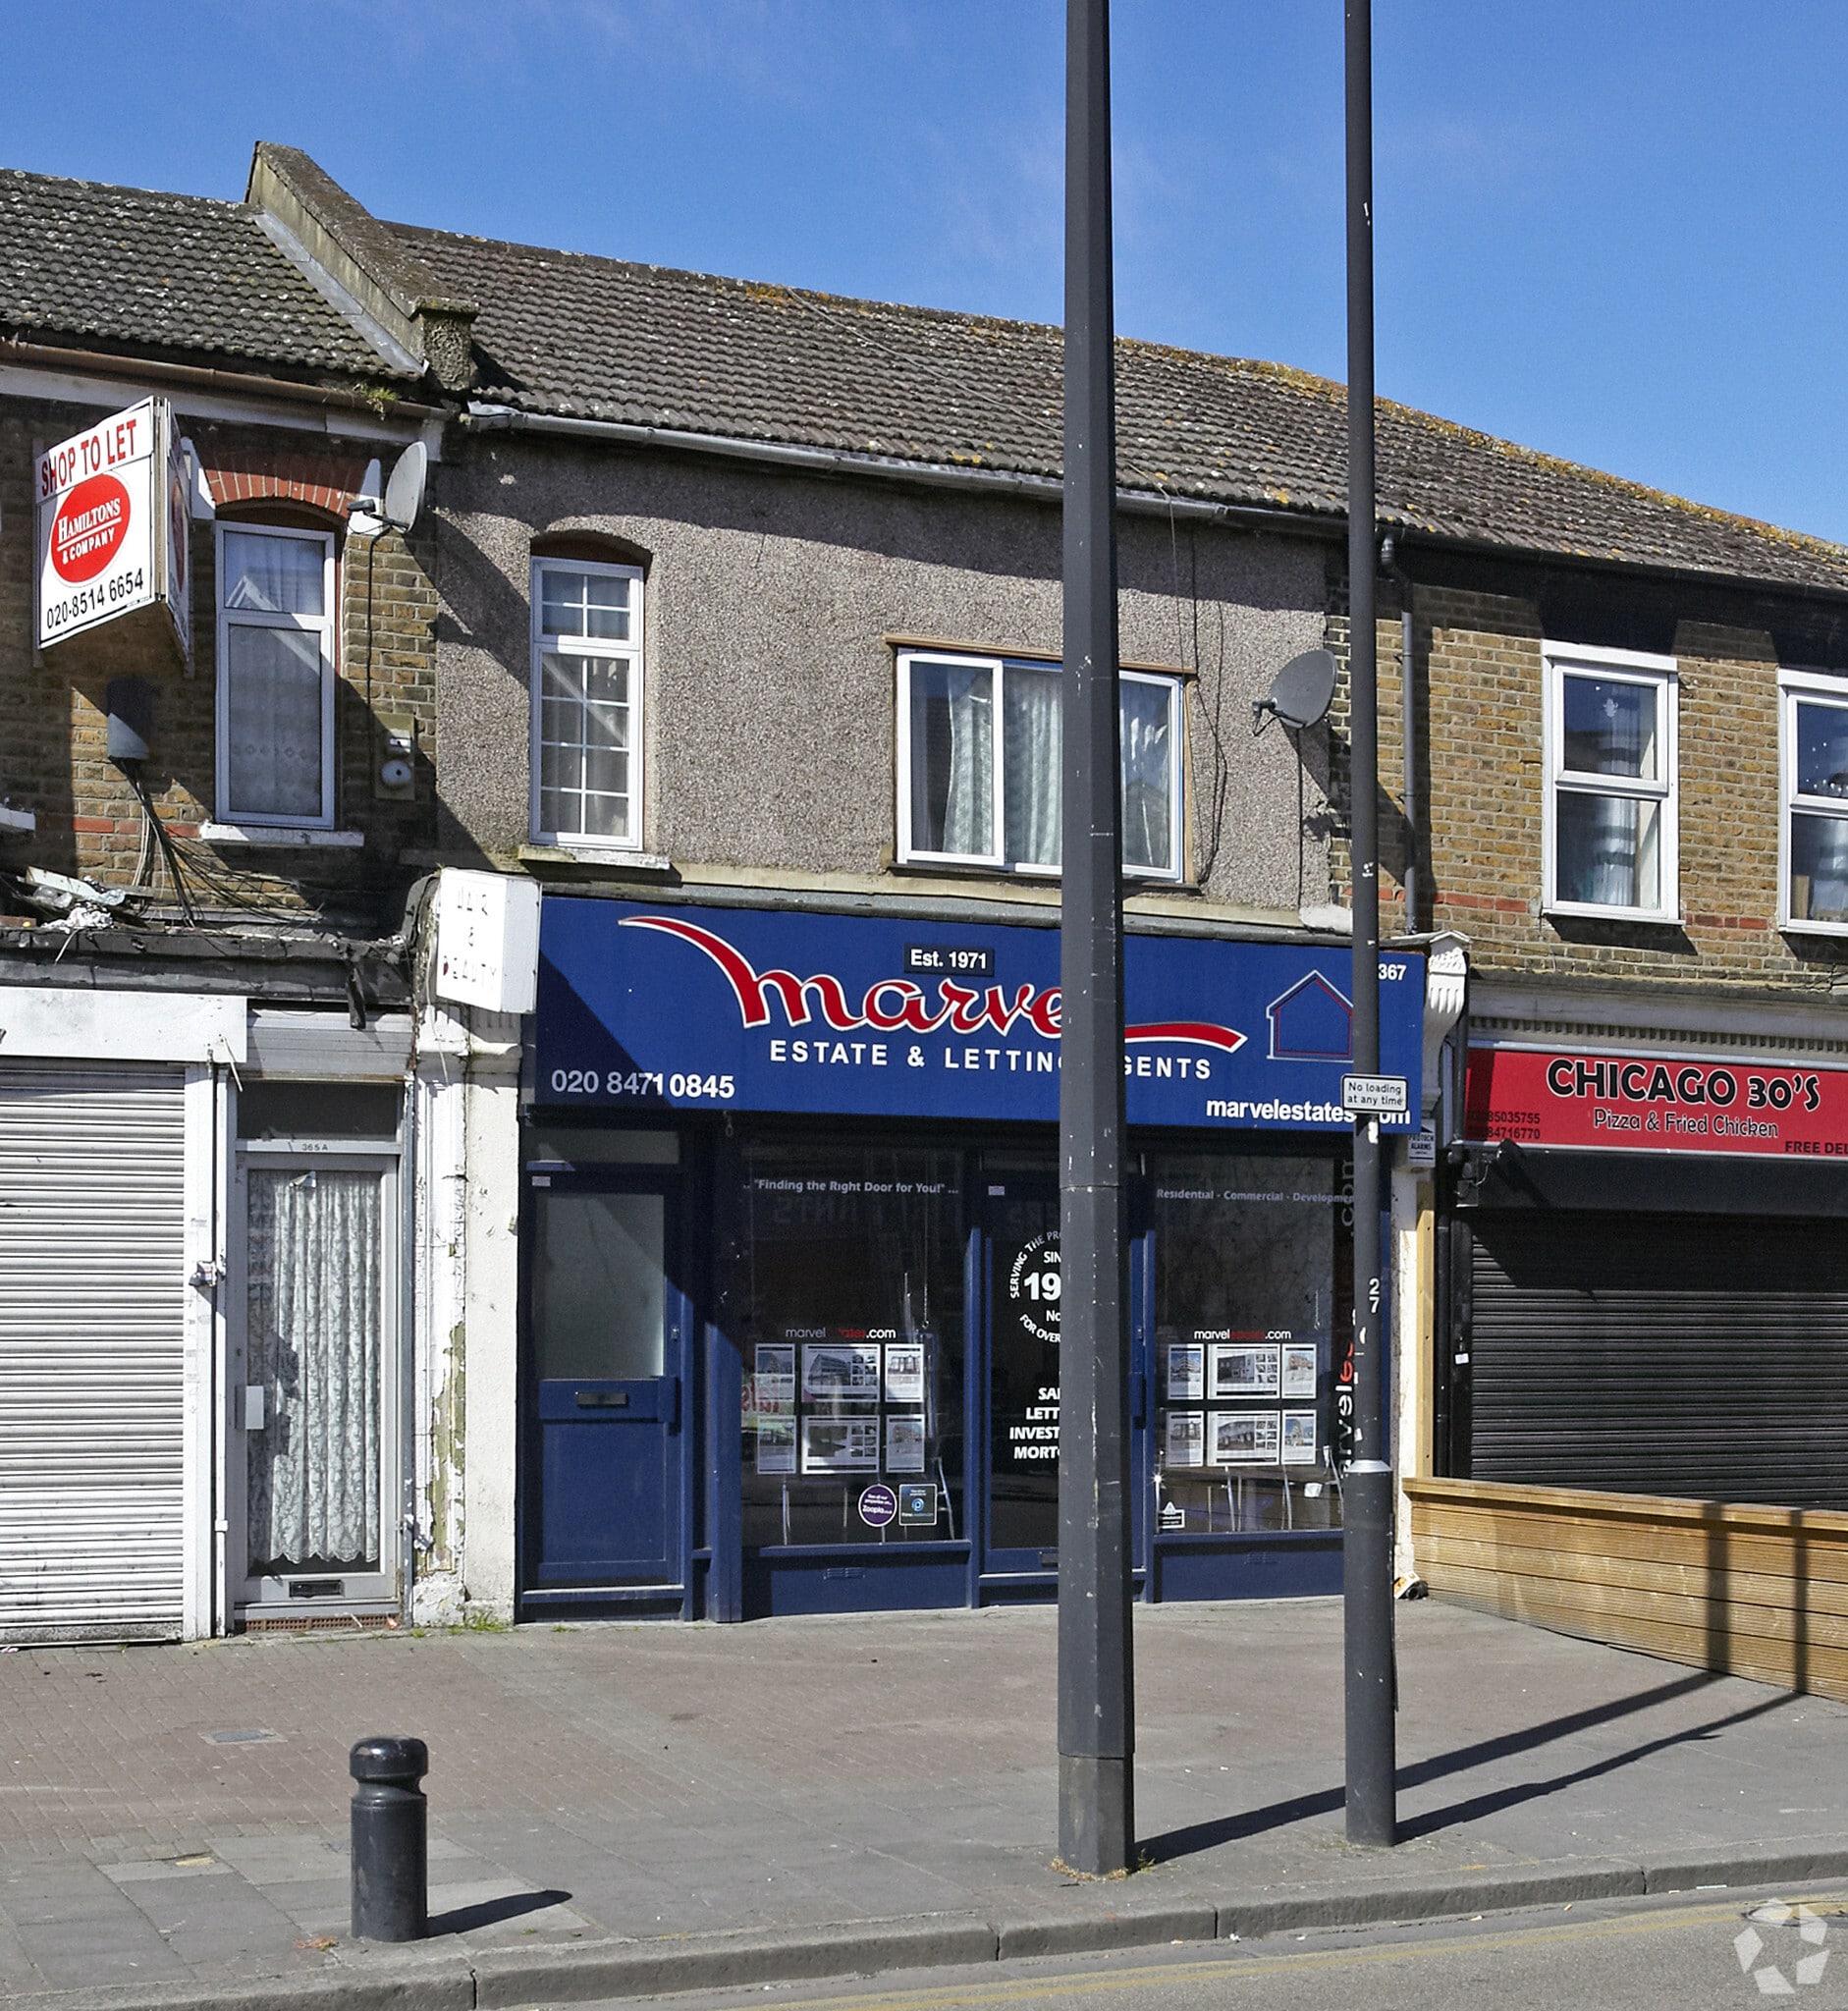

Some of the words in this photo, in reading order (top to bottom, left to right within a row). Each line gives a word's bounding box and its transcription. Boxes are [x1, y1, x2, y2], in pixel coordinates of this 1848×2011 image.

[41, 446, 76, 497] SHOP
[81, 435, 101, 475] TO
[106, 419, 136, 465] LET
[57, 498, 121, 544] HAMILTONS
[62, 550, 69, 565] &
[69, 526, 115, 561] COMPANY
[109, 568, 144, 601] 6654
[910, 949, 944, 967] Est.
[949, 951, 986, 969] 1971
[1378, 963, 1407, 981] 367
[770, 1040, 888, 1066] ESTATE
[907, 1047, 925, 1067] &
[945, 1049, 1061, 1072] LETTIN
[551, 1069, 599, 1093] 020
[606, 1071, 663, 1095] 8471
[669, 1073, 735, 1099] 0845
[1348, 1082, 1363, 1092] No
[1366, 1083, 1401, 1095] loading
[1546, 1059, 1737, 1108] CHICAGO
[1747, 1073, 1821, 1112] 30'S
[1361, 1097, 1378, 1106] any
[1382, 1096, 1402, 1106] time
[1594, 1108, 1641, 1131] Pizza
[1647, 1112, 1660, 1132] &
[1664, 1112, 1709, 1135] Fried
[1712, 1114, 1779, 1138] Chicken
[1784, 1141, 1821, 1155] FREE
[807, 1180, 826, 1190] the
[830, 1181, 861, 1194] Right
[864, 1181, 892, 1192] Door
[896, 1182, 912, 1193] for
[1157, 1188, 1214, 1200] Residential
[1223, 1189, 1283, 1202] Commercial
[1009, 1251, 1028, 1299] SERVING
[1024, 1234, 1045, 1252] THE
[1019, 1314, 1037, 1333] FOR
[1036, 1328, 1061, 1342] OVER
[1009, 1426, 1060, 1440] INVEST
[1013, 1445, 1060, 1459] MORT
